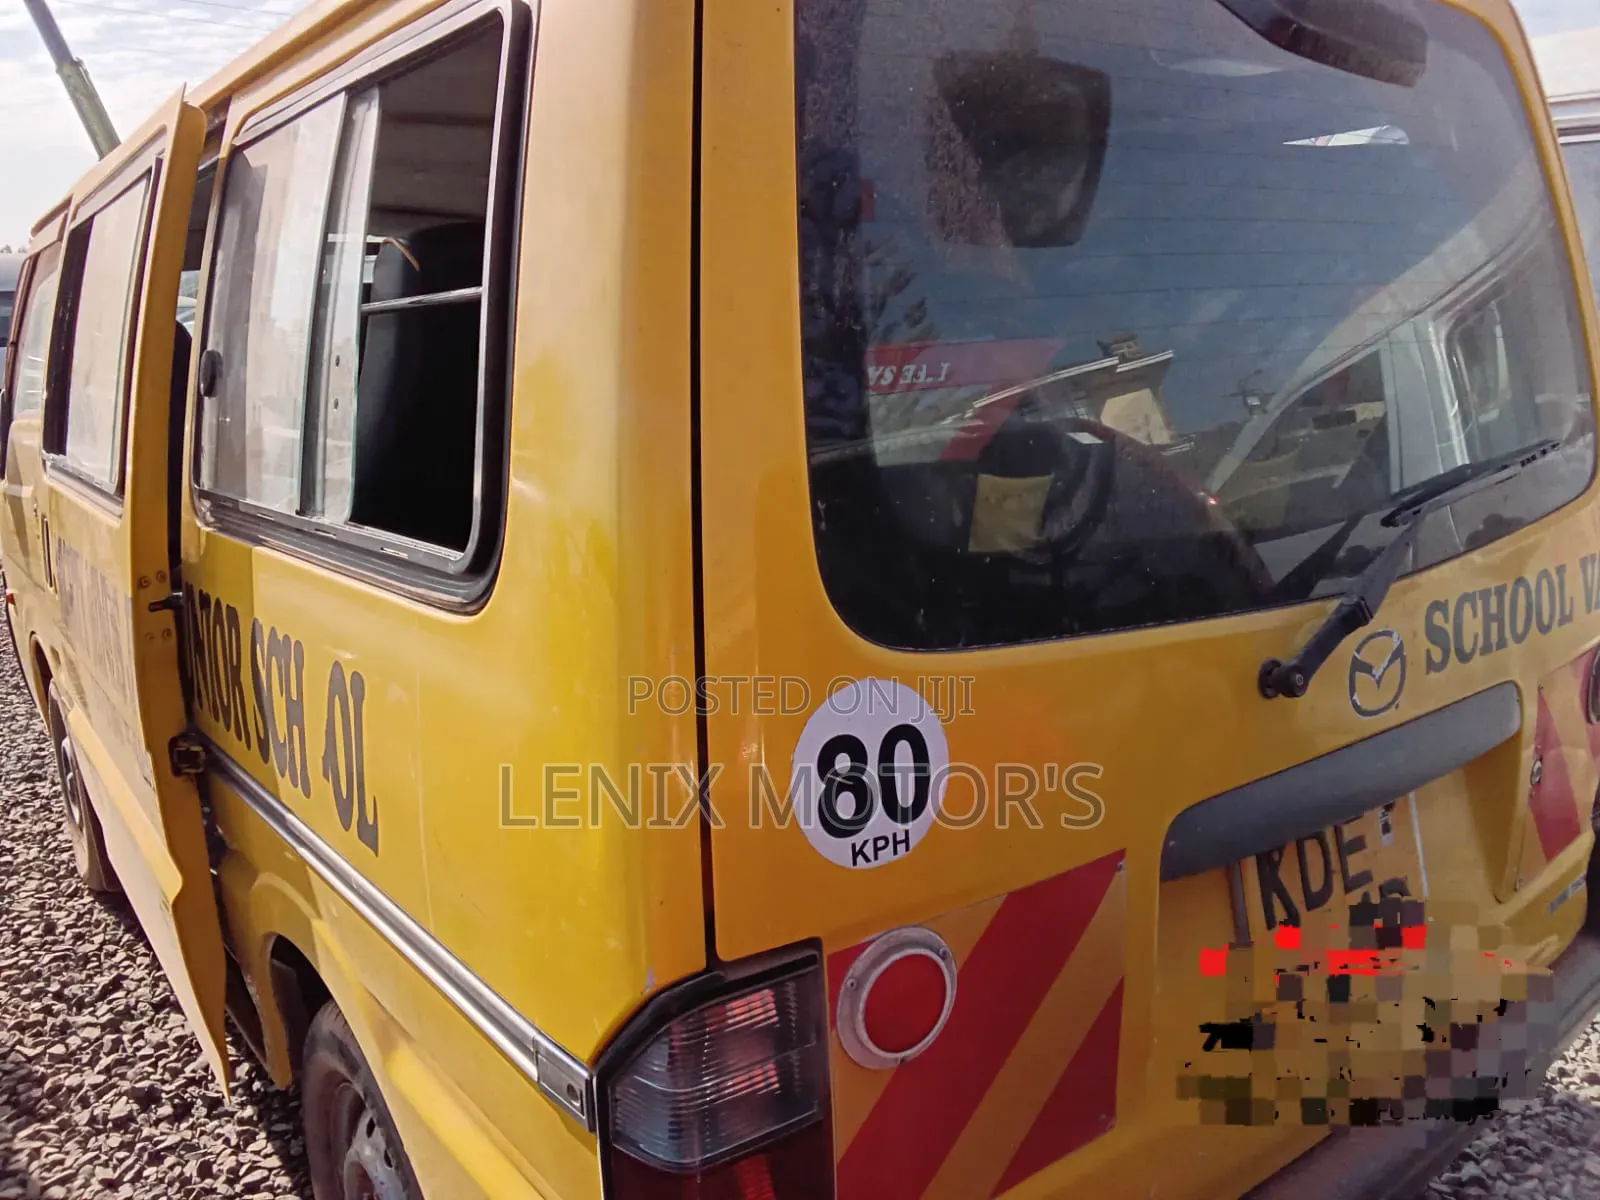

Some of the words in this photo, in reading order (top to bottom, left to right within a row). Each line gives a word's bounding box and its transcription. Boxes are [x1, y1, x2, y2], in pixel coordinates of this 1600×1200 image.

[1424, 563, 1574, 675] SCHOOL
[816, 723, 931, 838] 80
[850, 829, 911, 867] KPH
[1256, 815, 1374, 931] KDE
